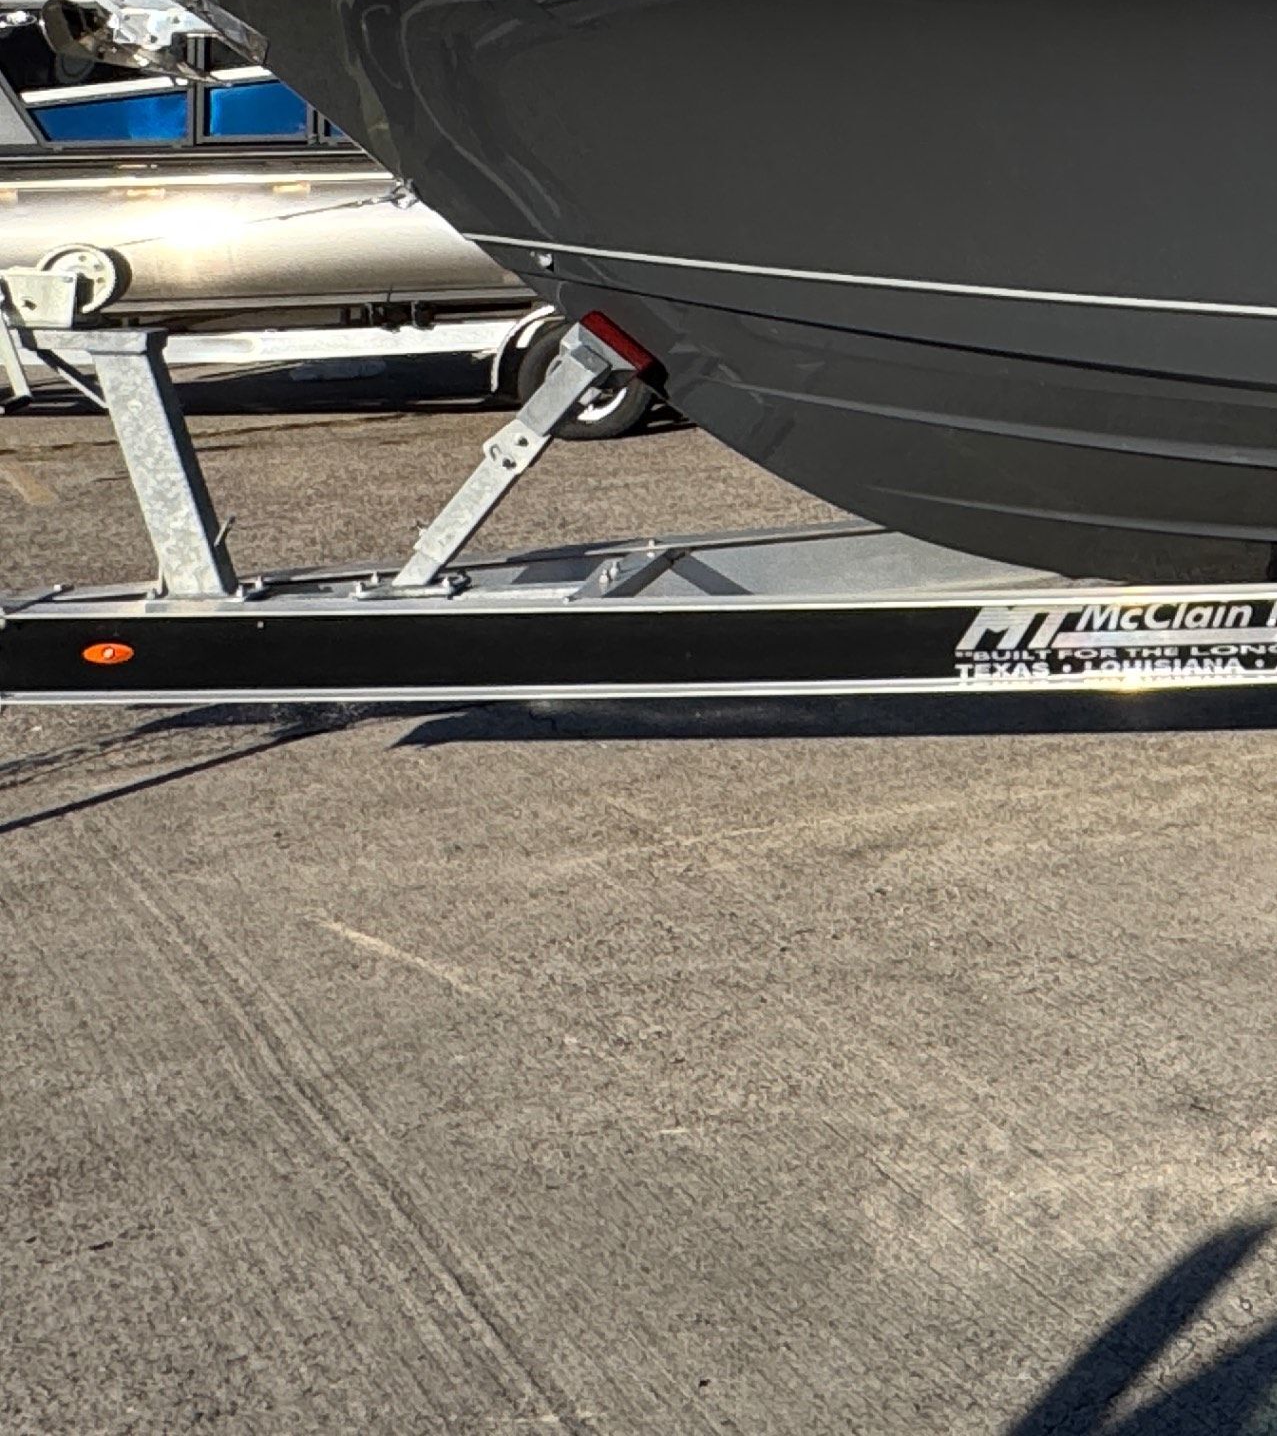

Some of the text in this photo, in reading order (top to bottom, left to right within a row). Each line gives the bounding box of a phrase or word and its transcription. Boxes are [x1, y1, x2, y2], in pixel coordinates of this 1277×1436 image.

[1075, 602, 1253, 631] McClain
[1058, 647, 1117, 660] FOR
[1124, 645, 1179, 658] THE
[955, 662, 1051, 679] TEXAS
